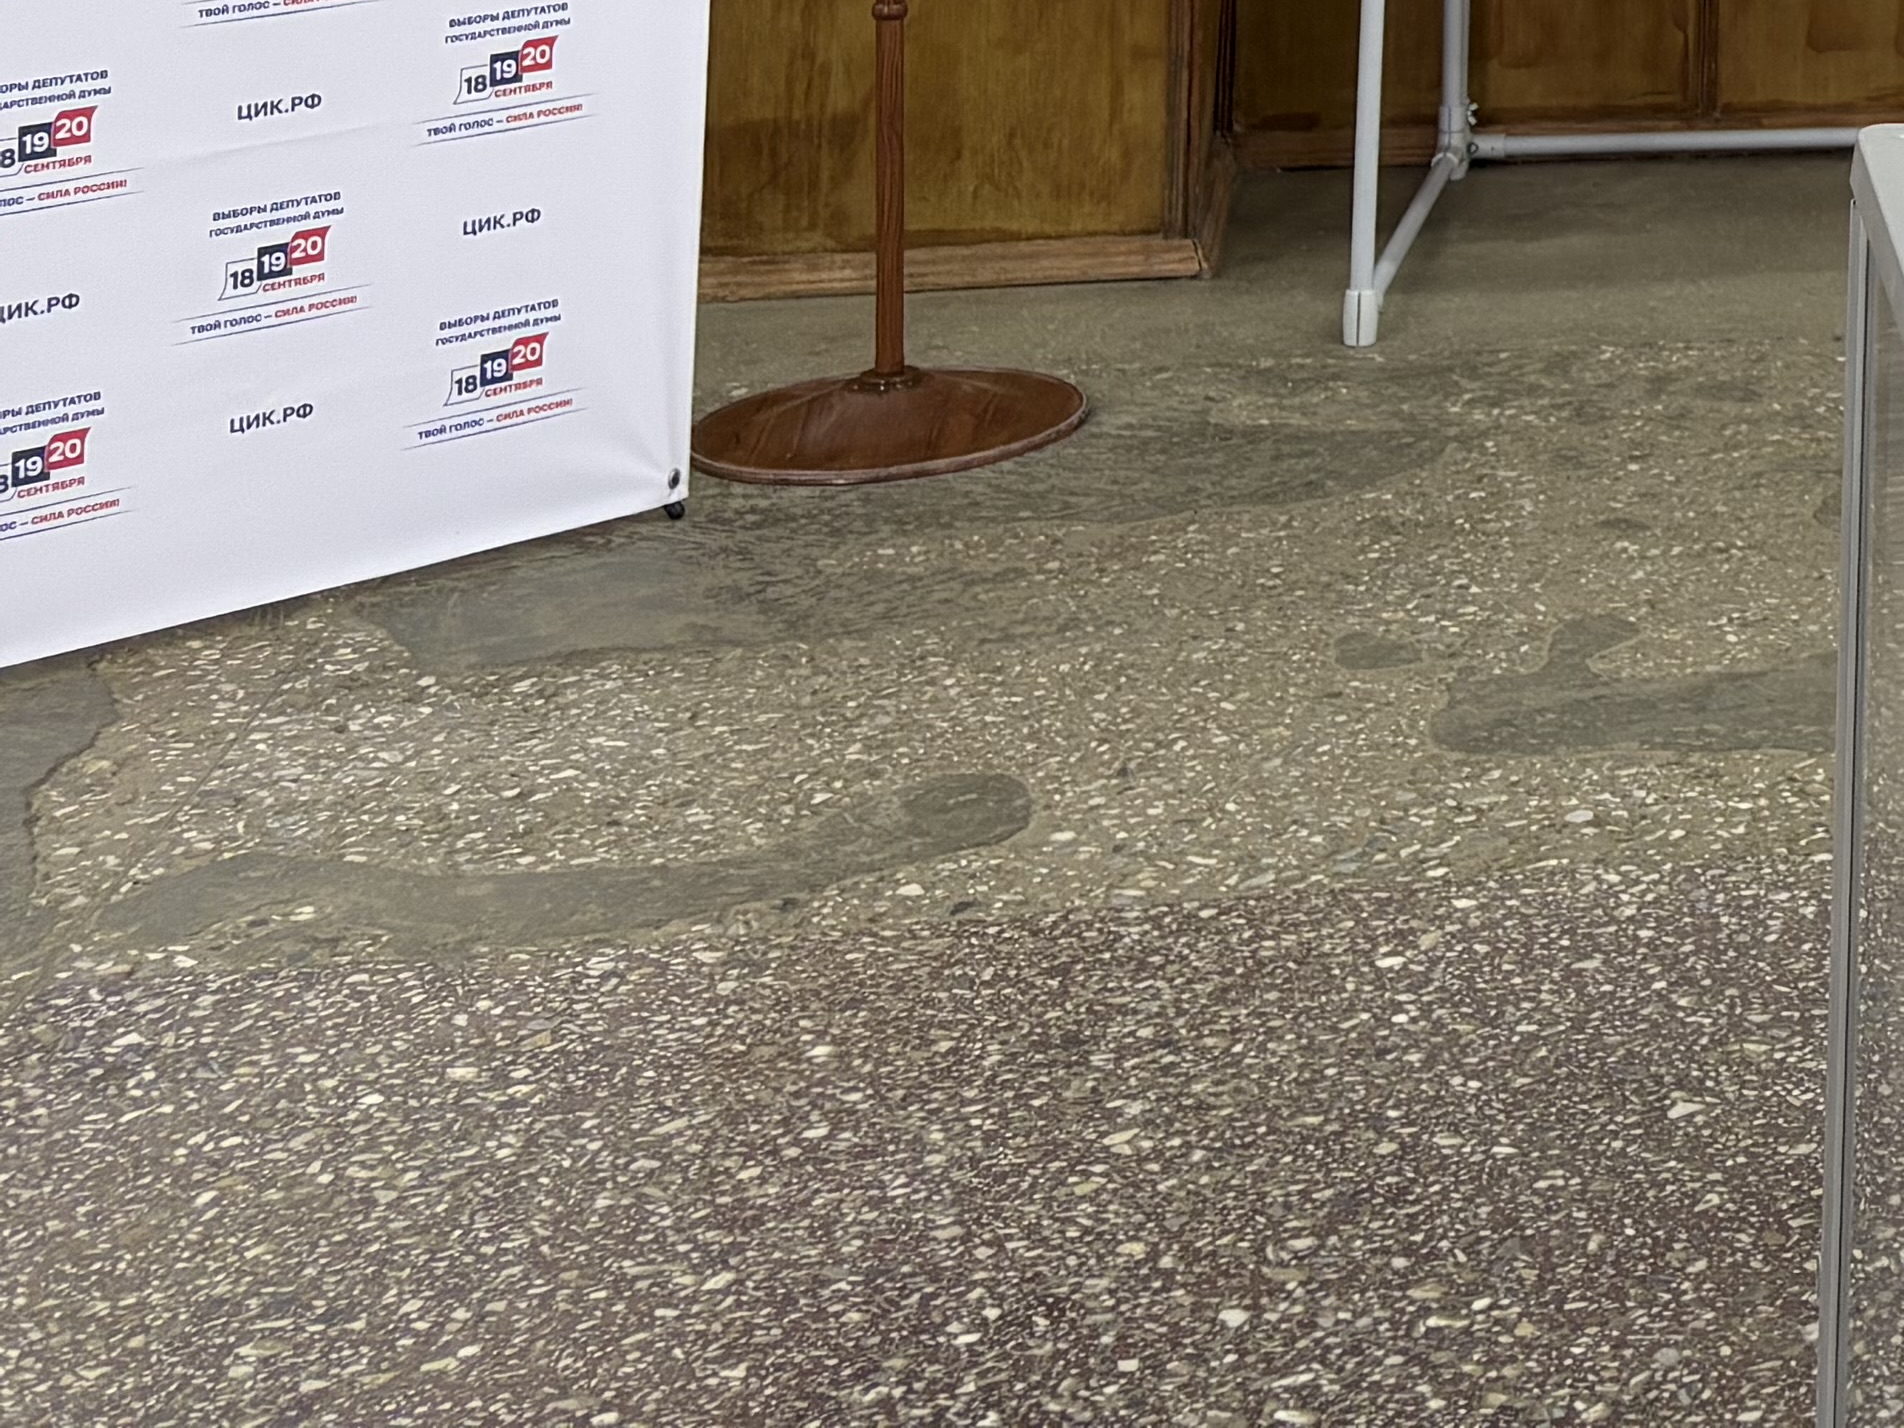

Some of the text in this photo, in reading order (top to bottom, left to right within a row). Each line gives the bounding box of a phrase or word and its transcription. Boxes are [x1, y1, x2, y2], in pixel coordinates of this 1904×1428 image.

[449, 2, 568, 28] ВЫБОРЫ ДЕПУТАТОВ
[32, 70, 108, 90] ДЕПУТАТОВ
[464, 45, 550, 94] 18 19 20
[495, 81, 552, 98] СЕНТЯБРЯ
[238, 94, 322, 120] ЦИК.РФ
[22, 132, 49, 154] 19
[56, 116, 88, 139] 20
[24, 155, 91, 174] СЕНТЯБРЯ
[213, 192, 340, 221] ВЫБОРЫ ДЕПУТАТОВ
[463, 208, 540, 236] ЦИК.РФ
[230, 236, 322, 290] 18 19 20
[262, 273, 324, 292] СЕНТЯБРЯ
[440, 299, 558, 330] ВЫБОРЫ ДЕПУТАТОВ
[455, 343, 540, 396] 18 19 20
[485, 378, 542, 397] СЕНТЯБРЯ
[25, 392, 101, 416] ДЕПУТАТОВ
[230, 404, 313, 434] ЦИК.РФ
[15, 439, 81, 478] 19 20
[18, 476, 84, 498] СЕНТЯБРЯ
